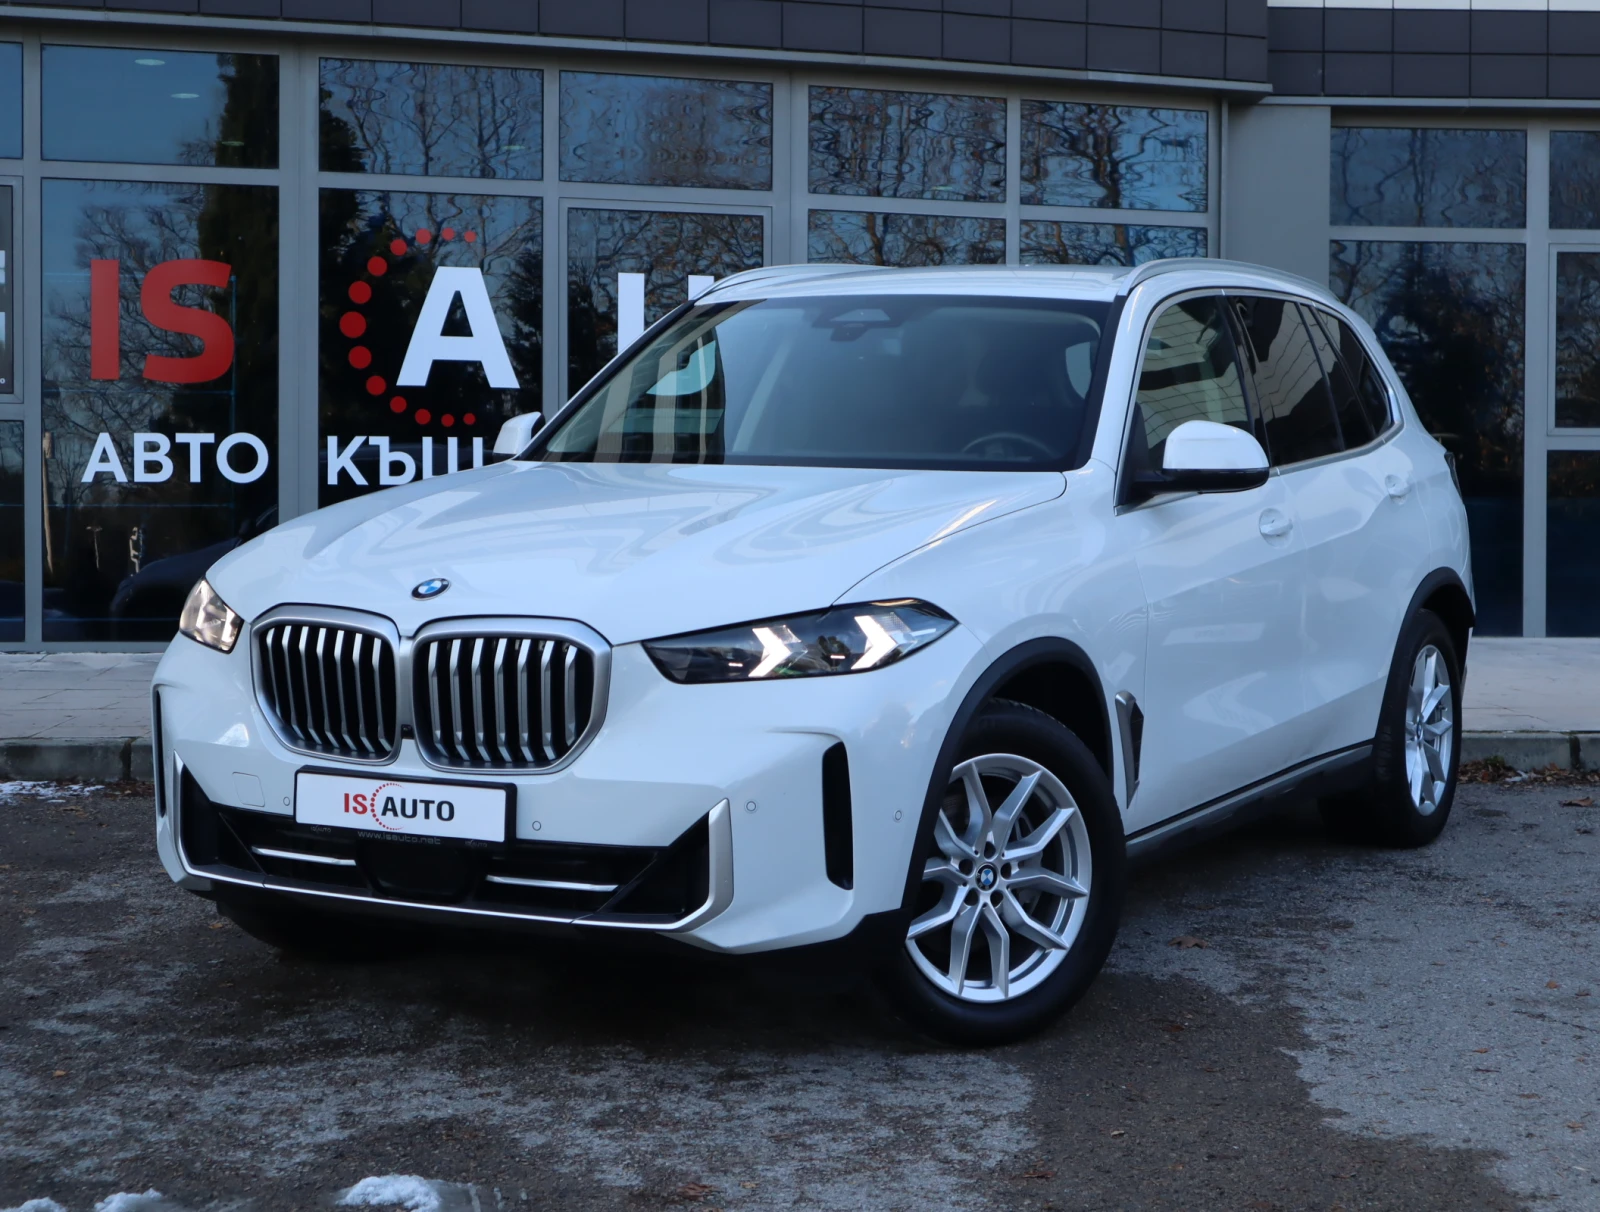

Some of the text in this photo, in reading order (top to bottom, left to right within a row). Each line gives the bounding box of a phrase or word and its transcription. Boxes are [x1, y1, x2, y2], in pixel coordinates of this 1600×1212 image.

[90, 258, 236, 384] IS
[81, 431, 269, 484] АВТО
[343, 792, 455, 822] IS AUTO
